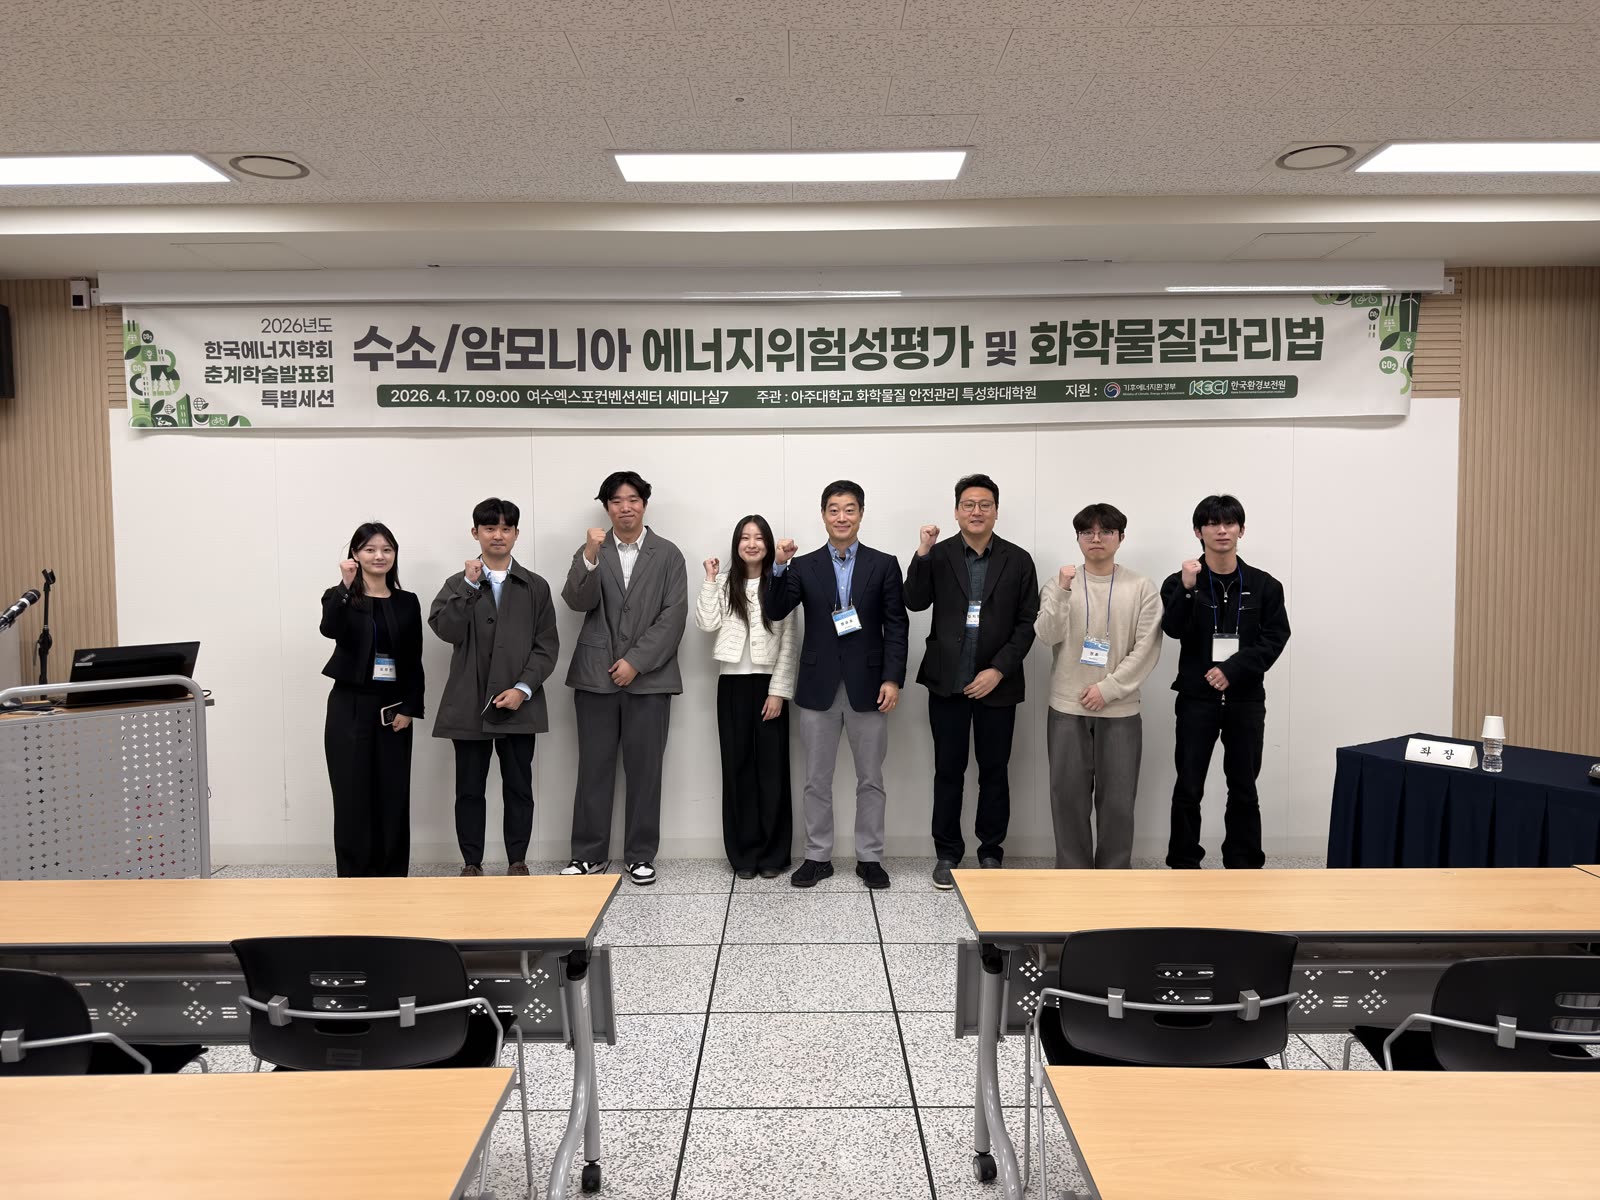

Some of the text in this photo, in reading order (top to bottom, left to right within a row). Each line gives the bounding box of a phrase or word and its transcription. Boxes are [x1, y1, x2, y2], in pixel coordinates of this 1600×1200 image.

[261, 318, 332, 333] 2026년도
[205, 340, 332, 359] 한국에너지학회
[354, 317, 1324, 372] 수소/암모니아 에너지위험성평가 및 화학물질관리법
[205, 365, 333, 384] 춘계학술발표회
[1231, 380, 1285, 390] 한국환경보전원
[261, 390, 334, 408] 특별세션
[391, 390, 729, 404] 2026. 4. 17. 09:00 여수엑스포컨벤션센터 세미나실7
[792, 390, 853, 403] 아주대학교
[857, 389, 905, 402] 화학물질
[910, 388, 958, 402] 안전관리
[962, 386, 1036, 401] 특성화대학원
